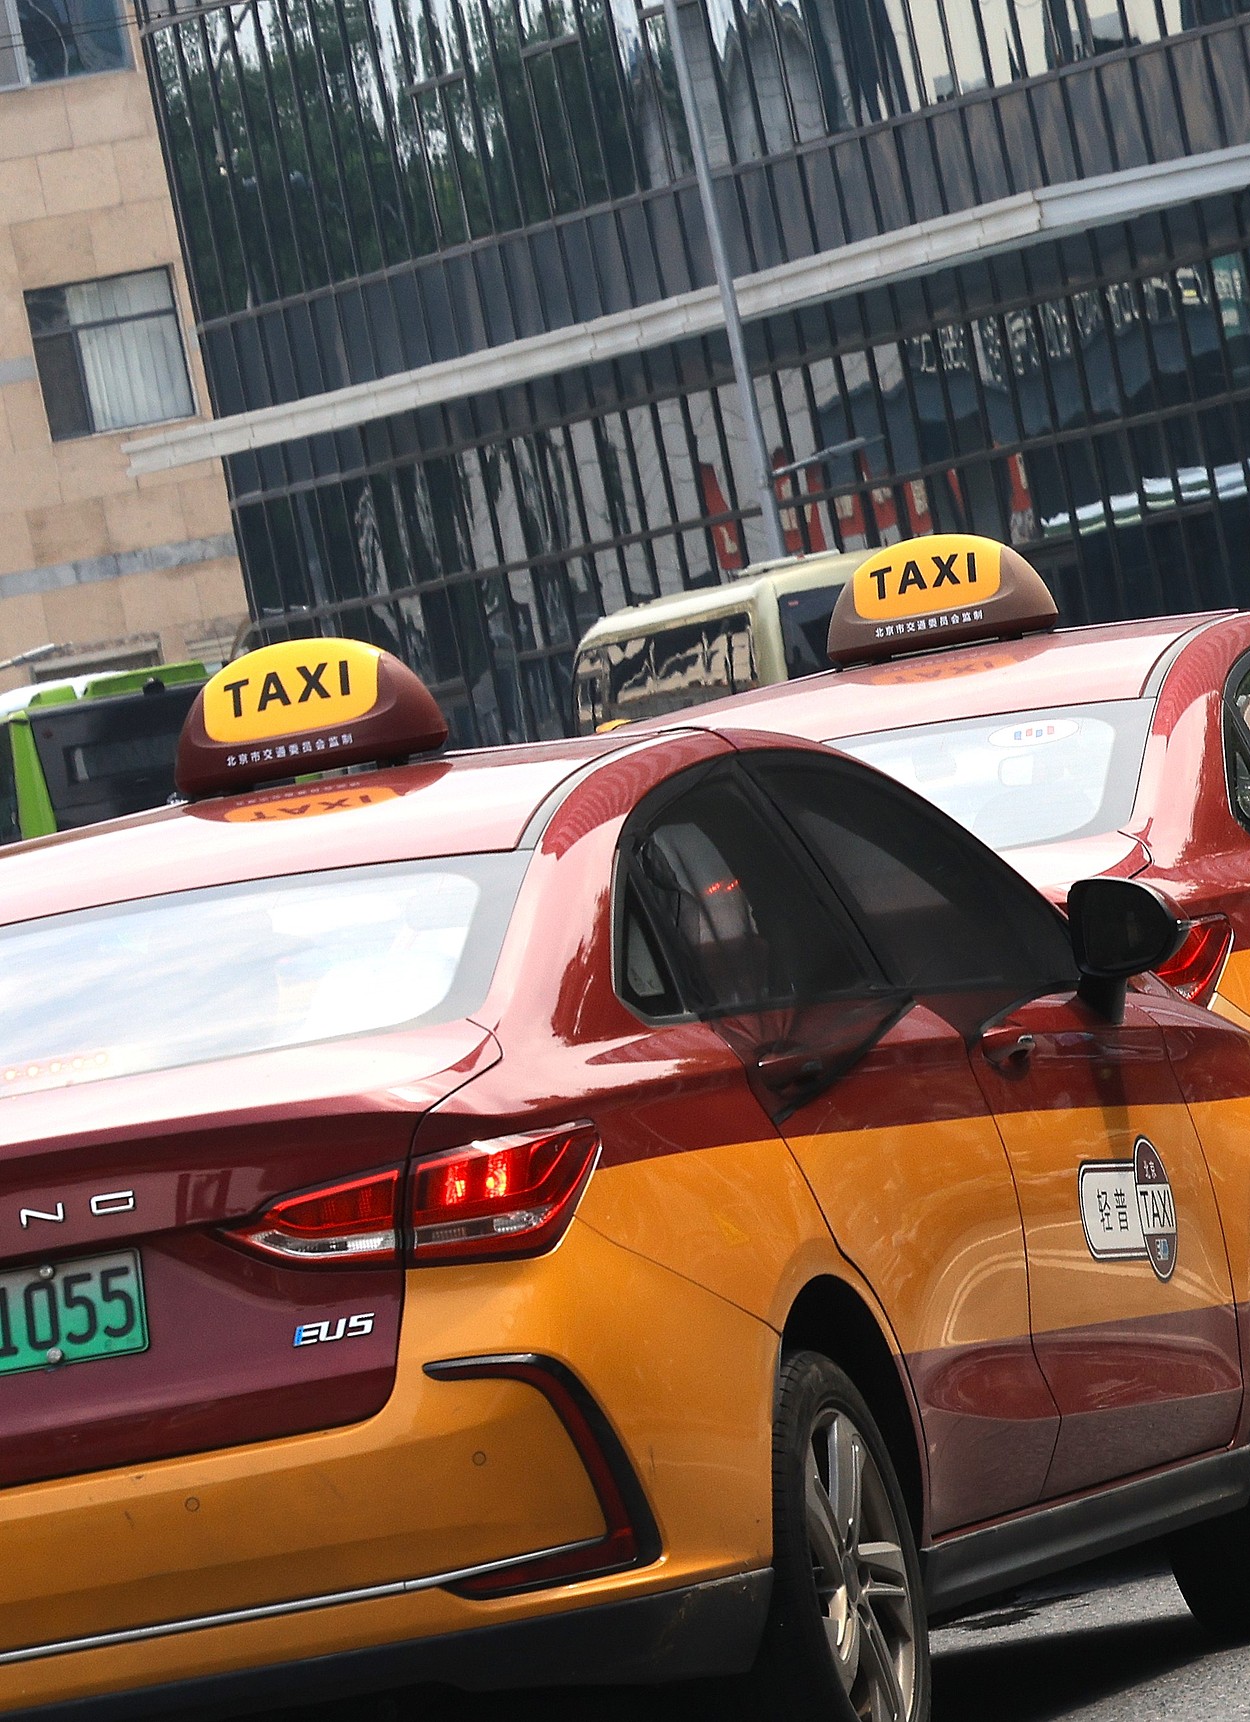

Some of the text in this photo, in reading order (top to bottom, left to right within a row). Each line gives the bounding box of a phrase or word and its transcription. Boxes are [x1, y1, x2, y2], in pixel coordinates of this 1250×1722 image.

[869, 552, 977, 600] TAXI
[875, 609, 984, 638] 北京市交通委员会监制
[223, 660, 351, 718] TAXI
[226, 732, 354, 767] 北京市交通委员会监制
[1140, 1189, 1175, 1228] TAXI
